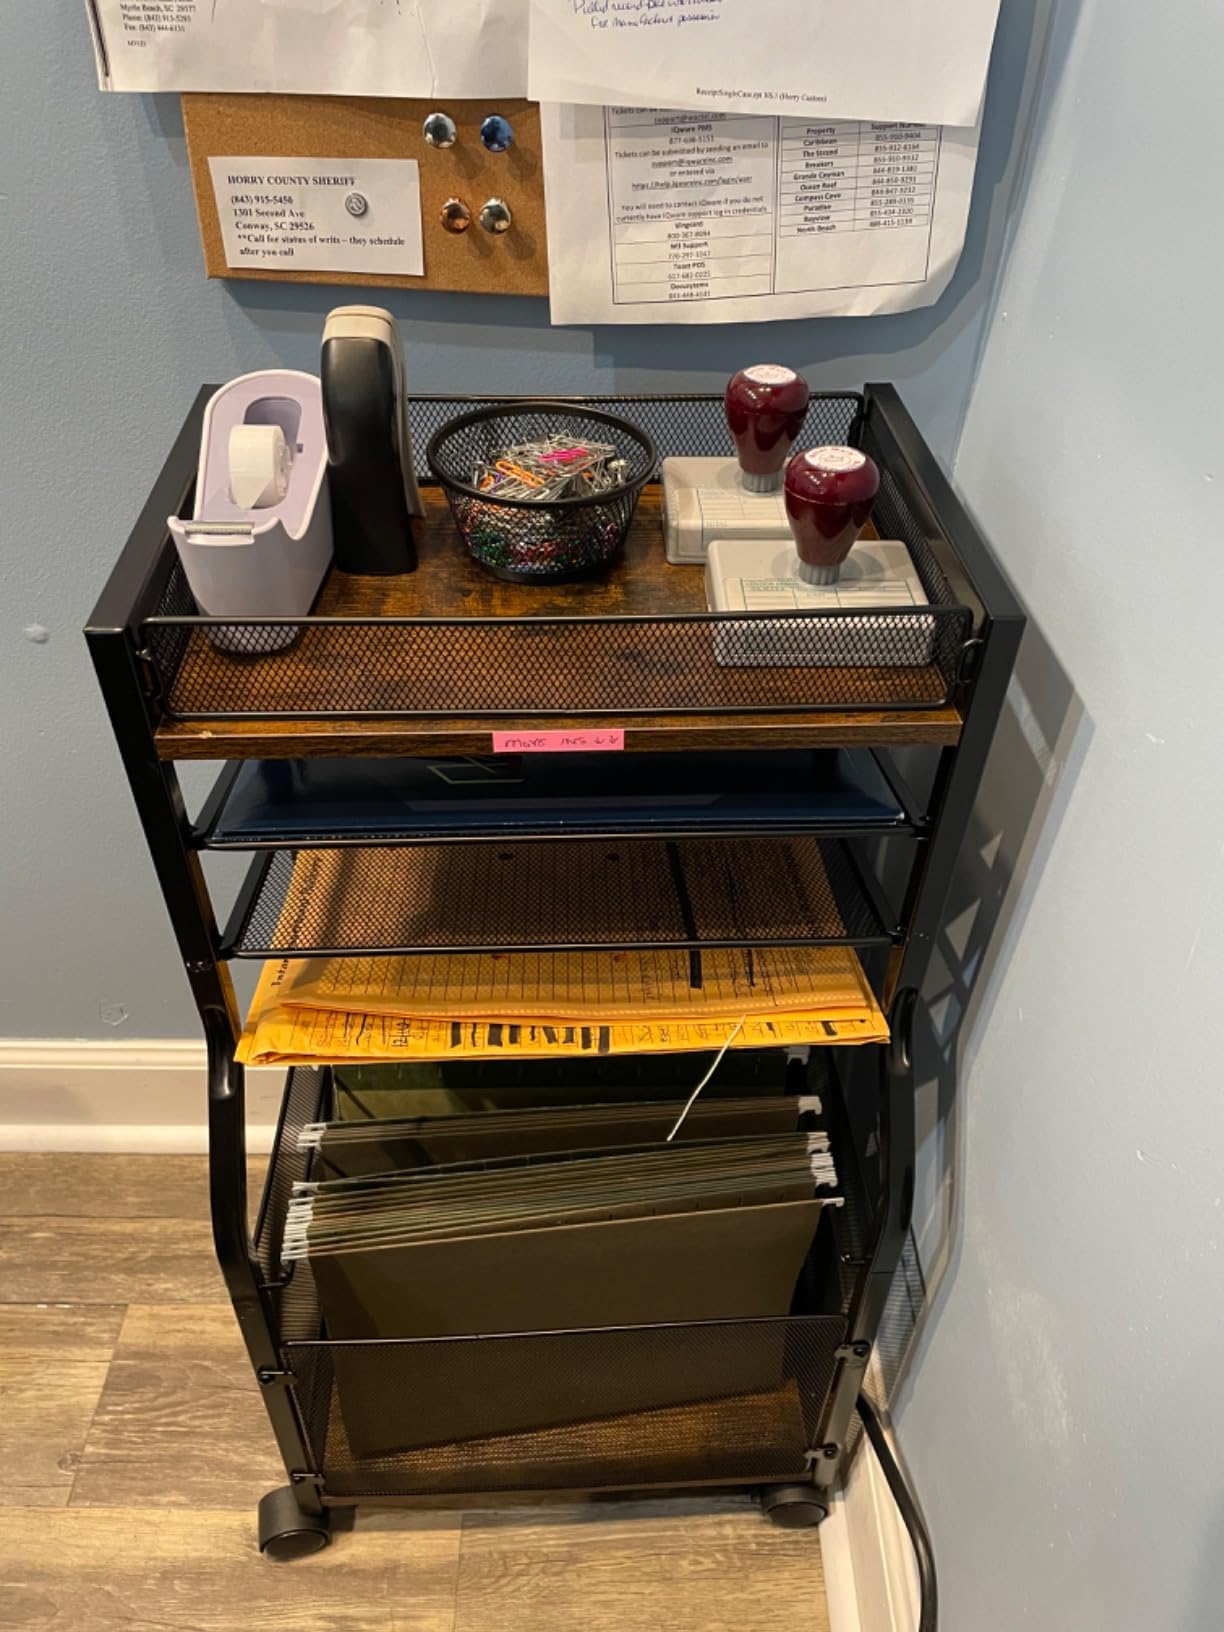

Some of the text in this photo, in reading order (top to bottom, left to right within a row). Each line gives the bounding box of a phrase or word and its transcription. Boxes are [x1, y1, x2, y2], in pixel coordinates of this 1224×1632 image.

[806, 128, 836, 136] Property
[803, 138, 837, 146] Caribbean
[803, 149, 838, 158] The Strand
[818, 171, 845, 180] Cayman
[227, 175, 356, 187] HORRY COUNTY SHERIFF
[800, 183, 820, 191] Ocean
[231, 195, 293, 206] (843) 915-5450
[795, 194, 824, 202] Compass
[234, 209, 304, 218] 1301 Second Ave
[235, 222, 314, 231] Conway, SC 29526
[817, 224, 836, 232] Beach
[267, 235, 278, 243] for
[281, 236, 307, 244] status
[309, 236, 317, 244] of
[319, 236, 340, 244] writs
[349, 237, 367, 246] they
[369, 237, 405, 246] schedule
[240, 248, 294, 258] after you call
